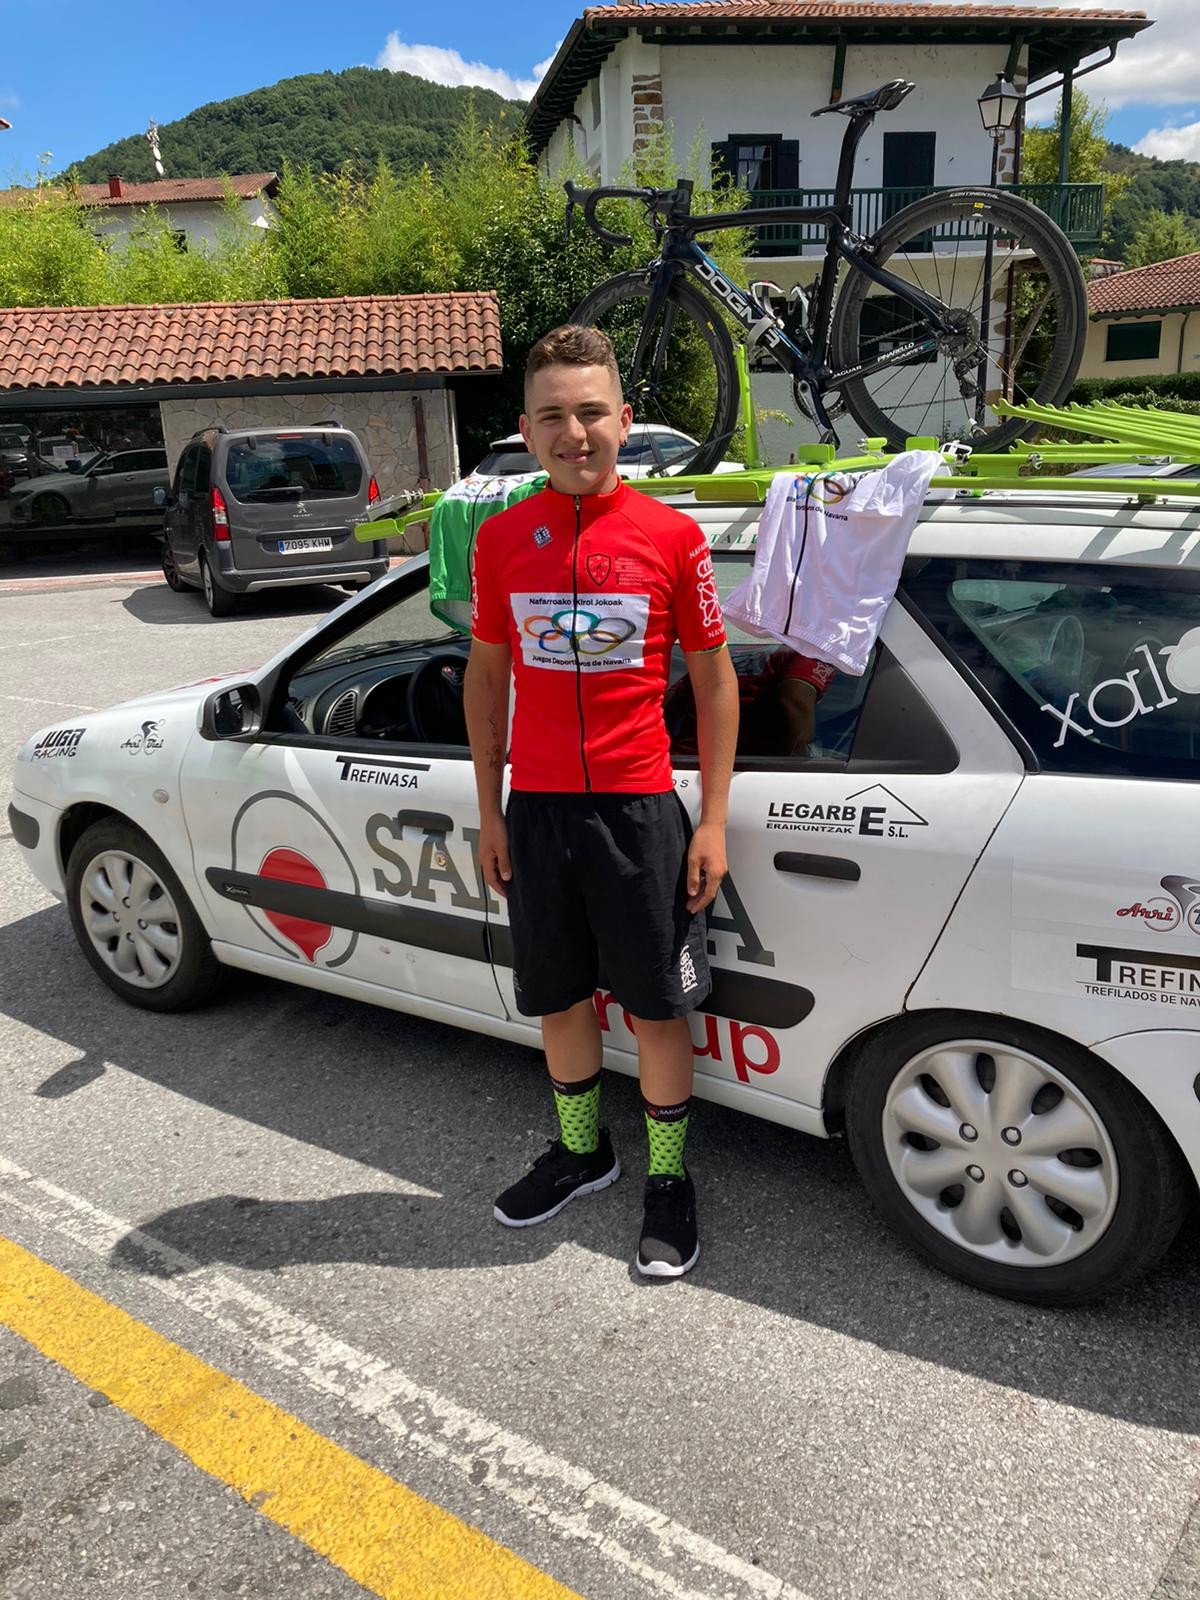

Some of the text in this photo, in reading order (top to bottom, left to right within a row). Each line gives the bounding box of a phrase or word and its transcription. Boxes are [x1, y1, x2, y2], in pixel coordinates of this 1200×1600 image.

[832, 365, 862, 379] JAGUAR
[823, 510, 848, 522] Navarra
[284, 538, 330, 551] 7095 KHM
[529, 598, 623, 607] Nafarroako Kirol Jokoak
[532, 655, 551, 664] Juegos
[592, 658, 602, 666] de
[604, 656, 631, 666] Navarra
[31, 747, 77, 762] RACING
[336, 755, 431, 789] TREFINASA
[766, 822, 909, 838] ERAIKUNTZAK S.L.
[1116, 902, 1174, 922] Arri
[1084, 985, 1157, 1002] TREFILADOS
[1160, 994, 1177, 1004] DE
